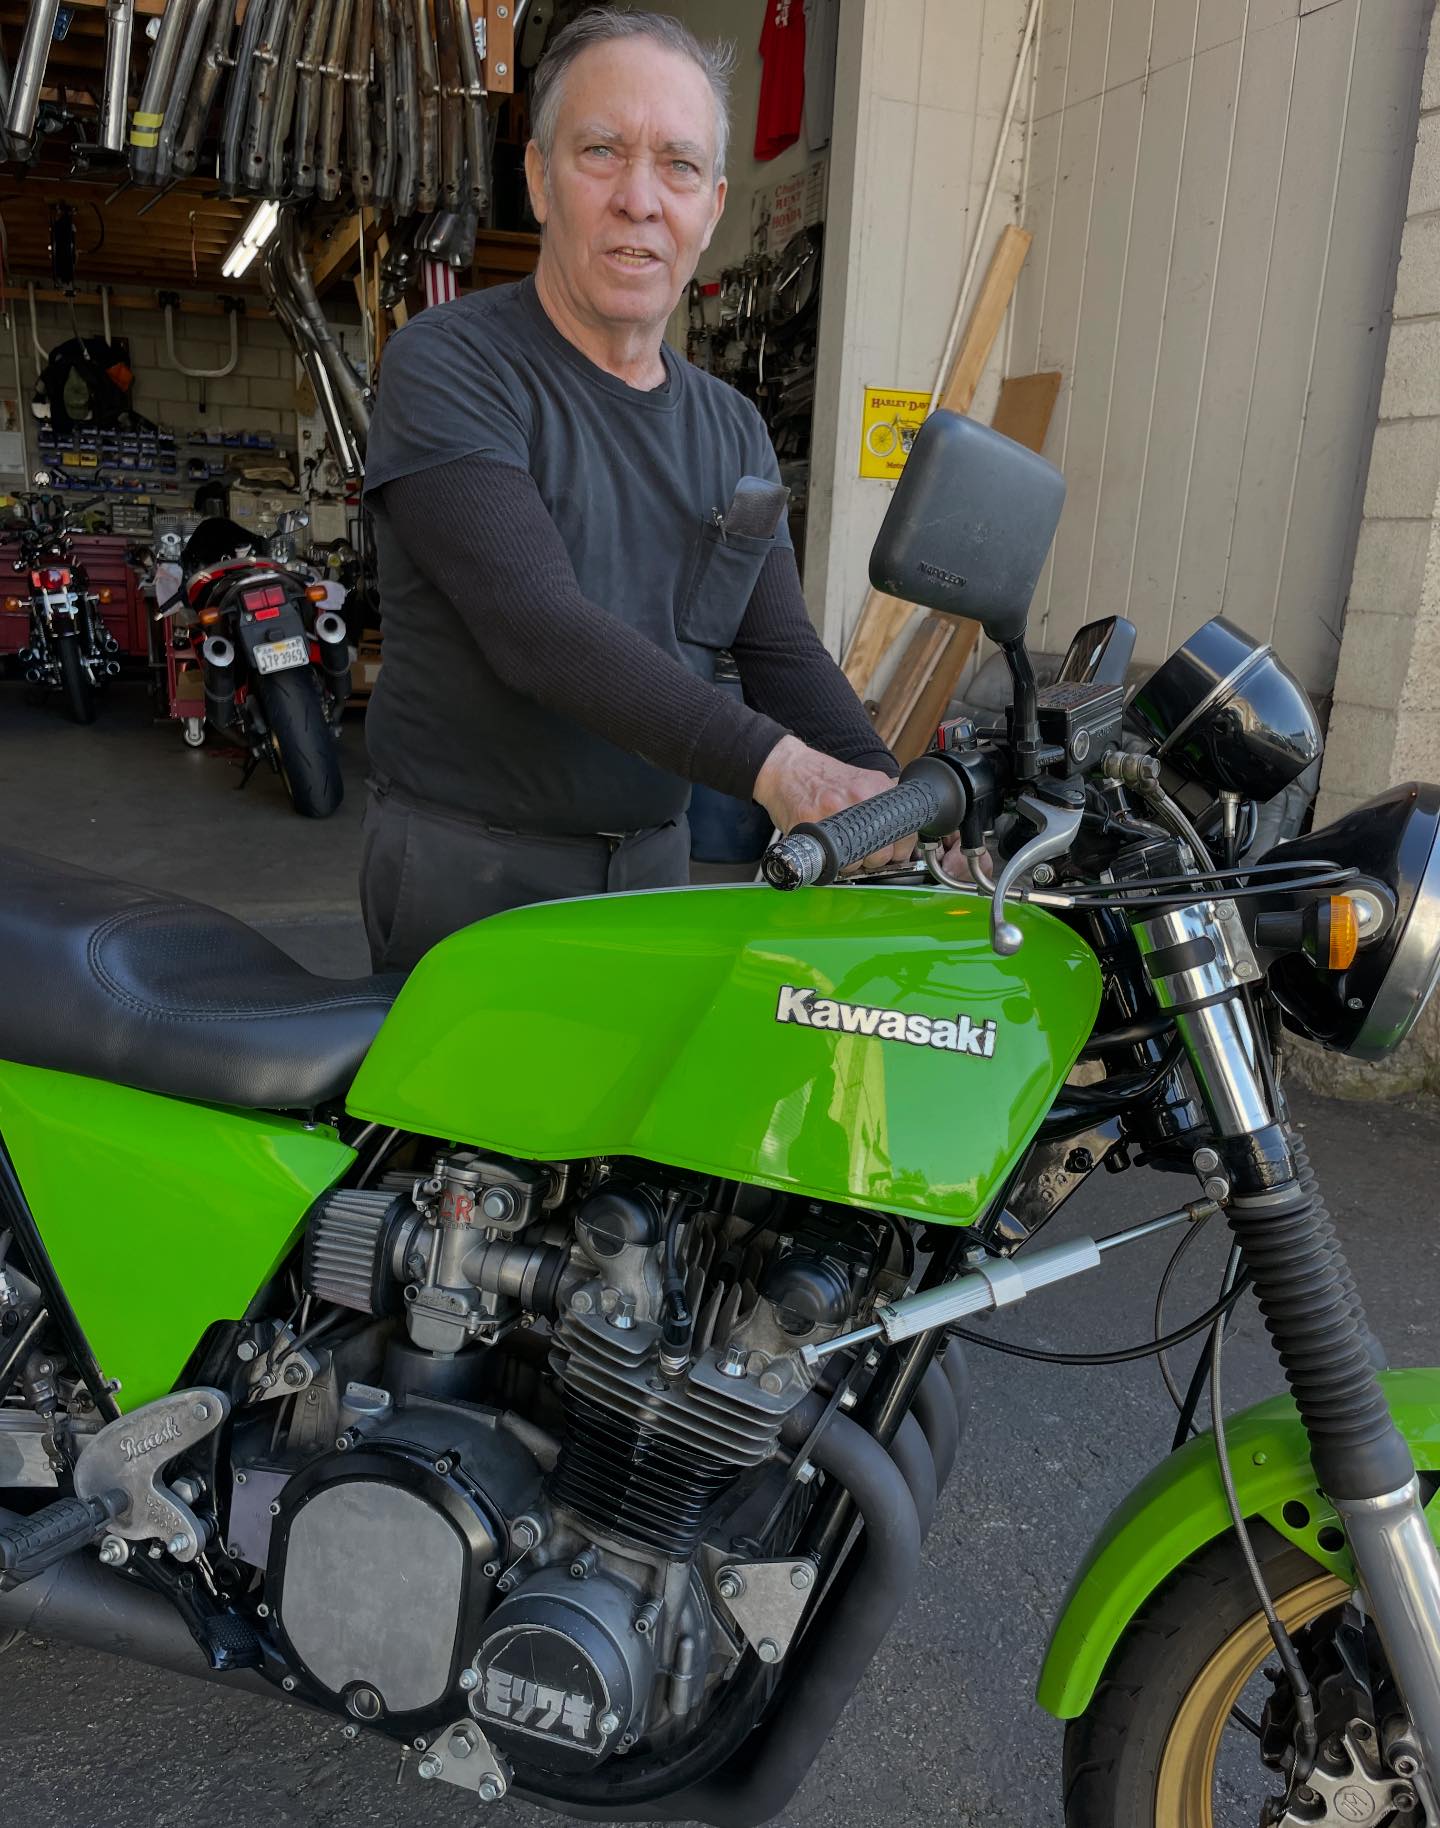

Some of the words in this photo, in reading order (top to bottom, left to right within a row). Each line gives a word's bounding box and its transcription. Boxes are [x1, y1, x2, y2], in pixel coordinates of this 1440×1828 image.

[776, 985, 998, 1059] Kawasaki
[485, 1667, 593, 1739] モリワキ
